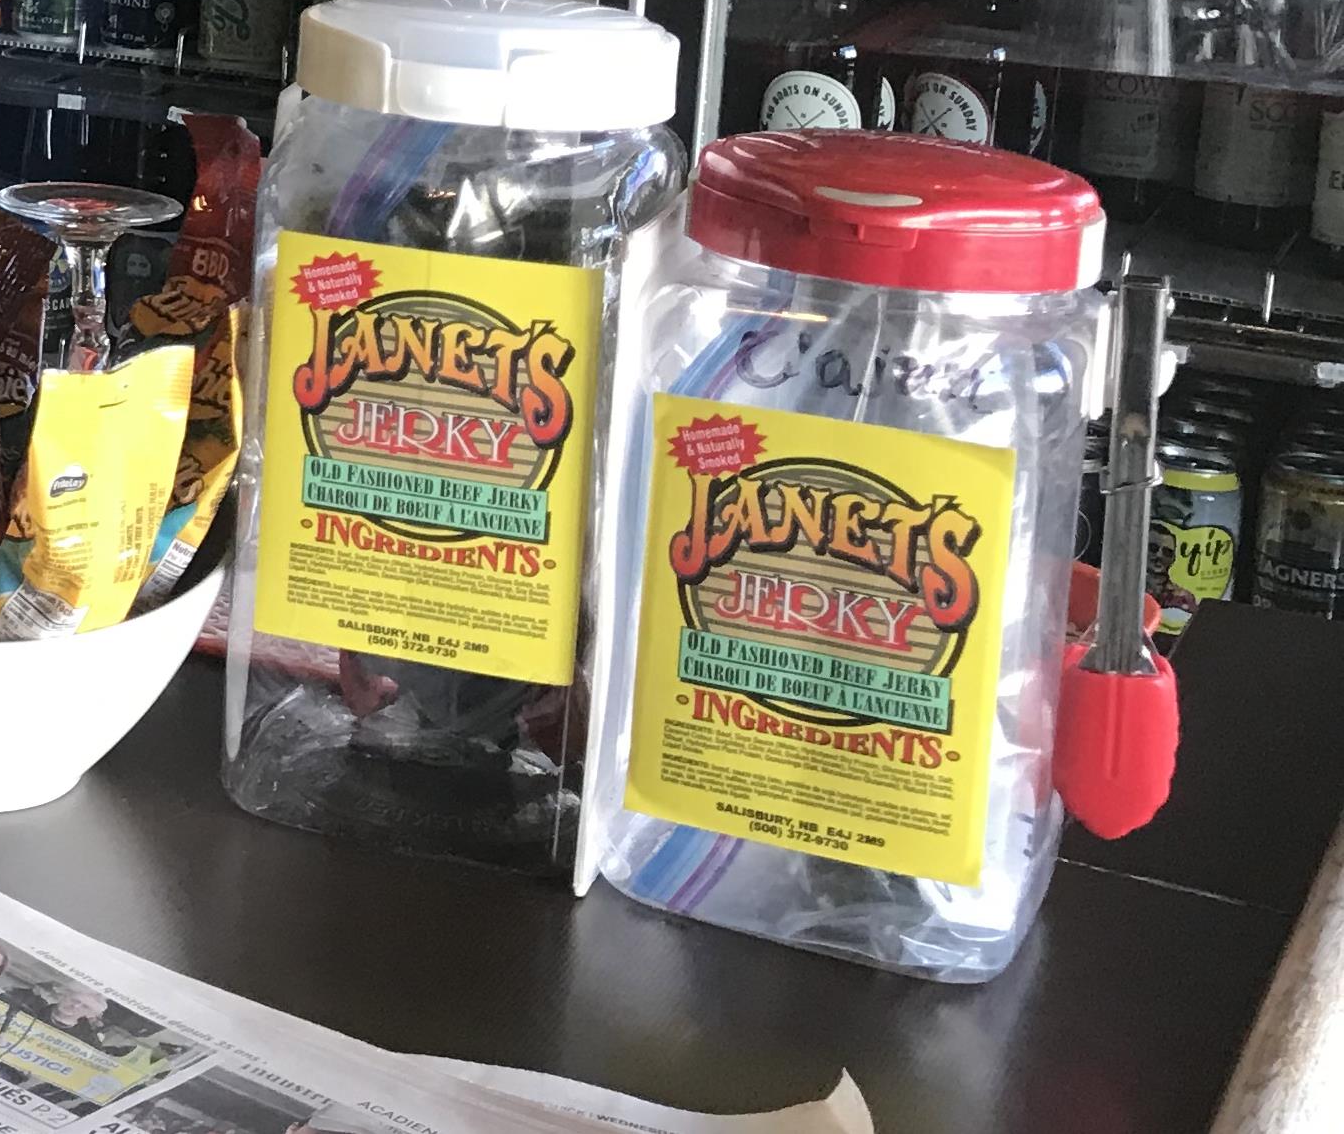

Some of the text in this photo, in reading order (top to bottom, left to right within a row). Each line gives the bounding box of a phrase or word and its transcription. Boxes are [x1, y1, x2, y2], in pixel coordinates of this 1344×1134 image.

[803, 84, 820, 99] ON
[820, 91, 850, 130] SUNDAY
[948, 90, 979, 132] SUNDAY
[303, 260, 358, 280] Homemade
[307, 272, 363, 292] & Naturally
[318, 287, 359, 306] Smoked
[293, 307, 577, 450] JANET'S
[336, 399, 524, 469] JERKY
[681, 423, 740, 444] Homemade
[686, 436, 746, 457] & Naturally
[310, 458, 544, 512] OLD FASHIONED BEEF JERKY
[697, 453, 742, 471] Smoked
[307, 482, 543, 538] CHARQUI DE BOEUF À L'ANCIENNE
[314, 513, 541, 579] INGREDIENTS
[669, 471, 984, 632] JANET'S
[1180, 528, 1232, 577] yip
[1258, 558, 1344, 589] AGNERS
[715, 570, 923, 651] JERKY
[337, 618, 490, 654] SALISBURY, NB E4J 2M9
[368, 634, 458, 658] (506) 372-9730
[687, 631, 944, 700] OLD FASHIONED BEEF JERKY
[684, 655, 944, 726] CHARQUI DE BOEUF À L'ANCIENNE
[691, 688, 944, 769] INGREDIENTS
[715, 801, 795, 828] SALISBURY,
[799, 818, 819, 833] NB
[826, 824, 853, 840] E4J
[104, 985, 168, 1026] quotidien
[167, 1017, 212, 1043] depuis
[0, 1040, 74, 1077] JUSTICE
